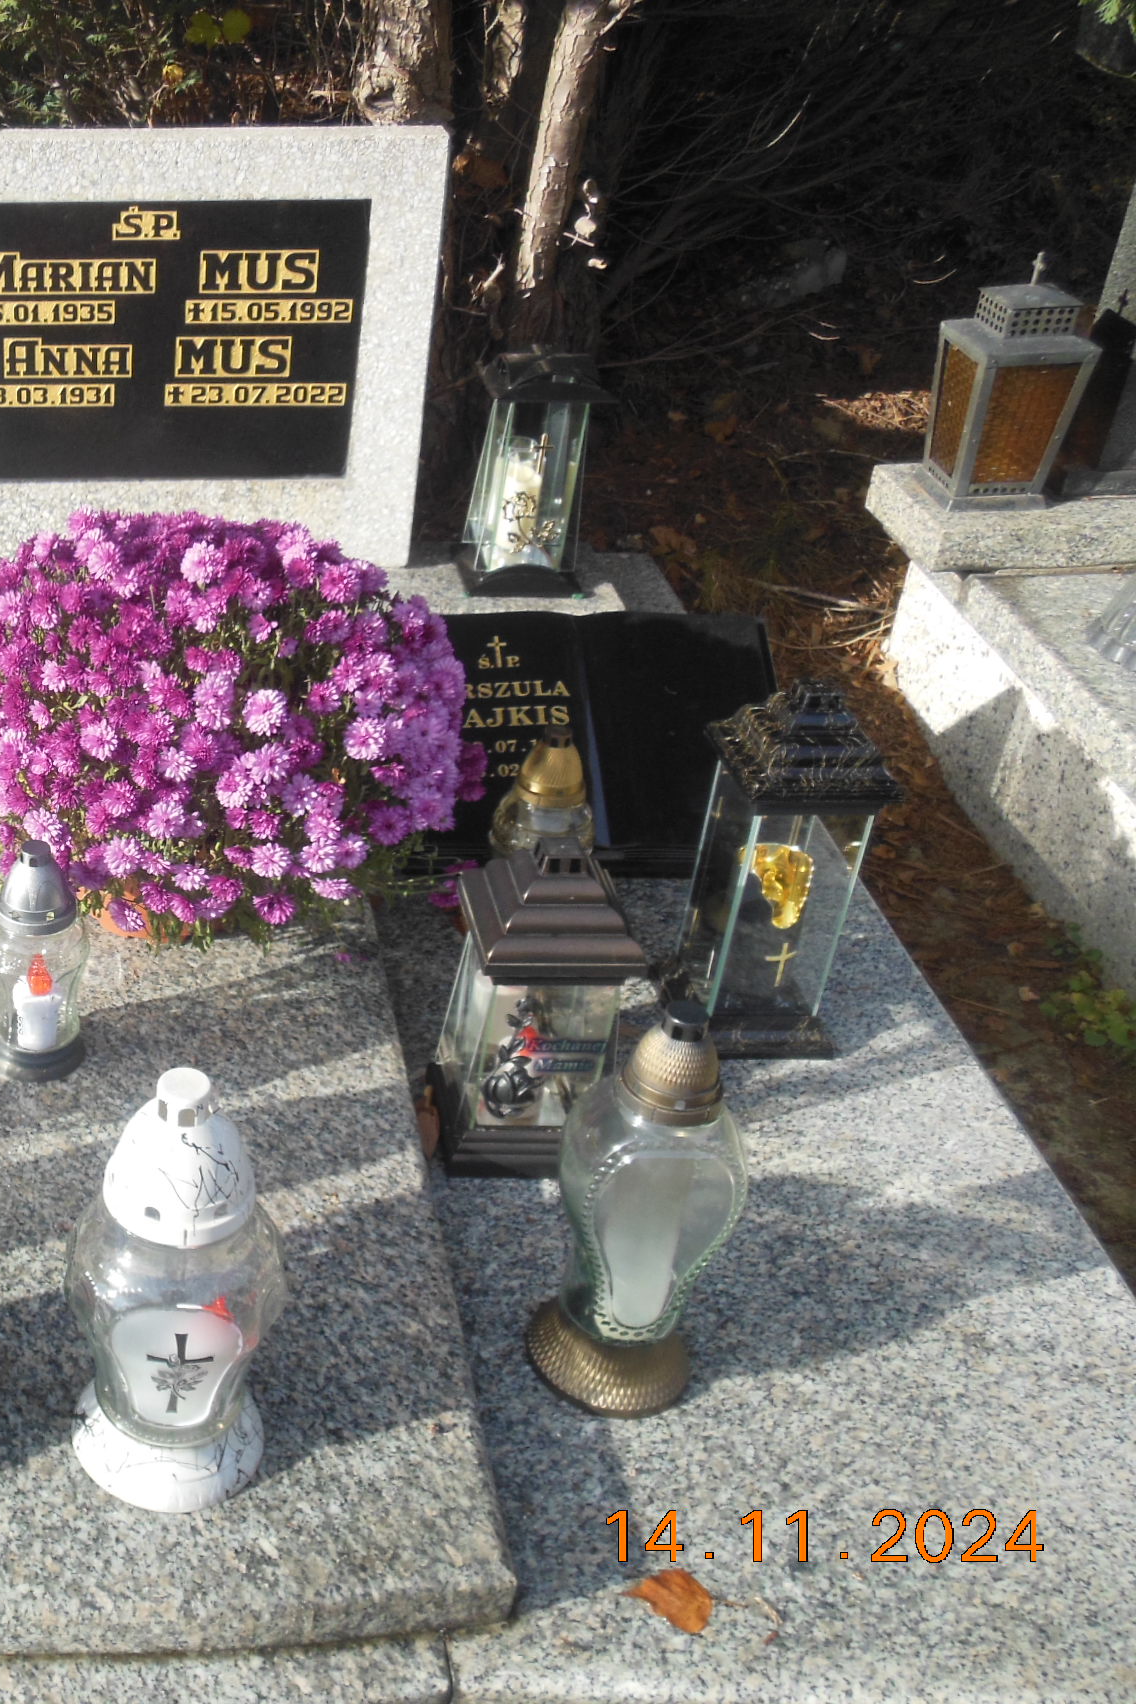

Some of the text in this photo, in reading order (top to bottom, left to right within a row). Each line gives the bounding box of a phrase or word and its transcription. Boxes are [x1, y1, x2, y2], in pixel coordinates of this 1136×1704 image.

[201, 252, 317, 291] MUS
[210, 301, 351, 322] 15.05.1992
[177, 338, 290, 375] MUS
[190, 385, 344, 404] 23.07.2022
[464, 680, 571, 699] RSZULA
[462, 705, 571, 728] AJKIS
